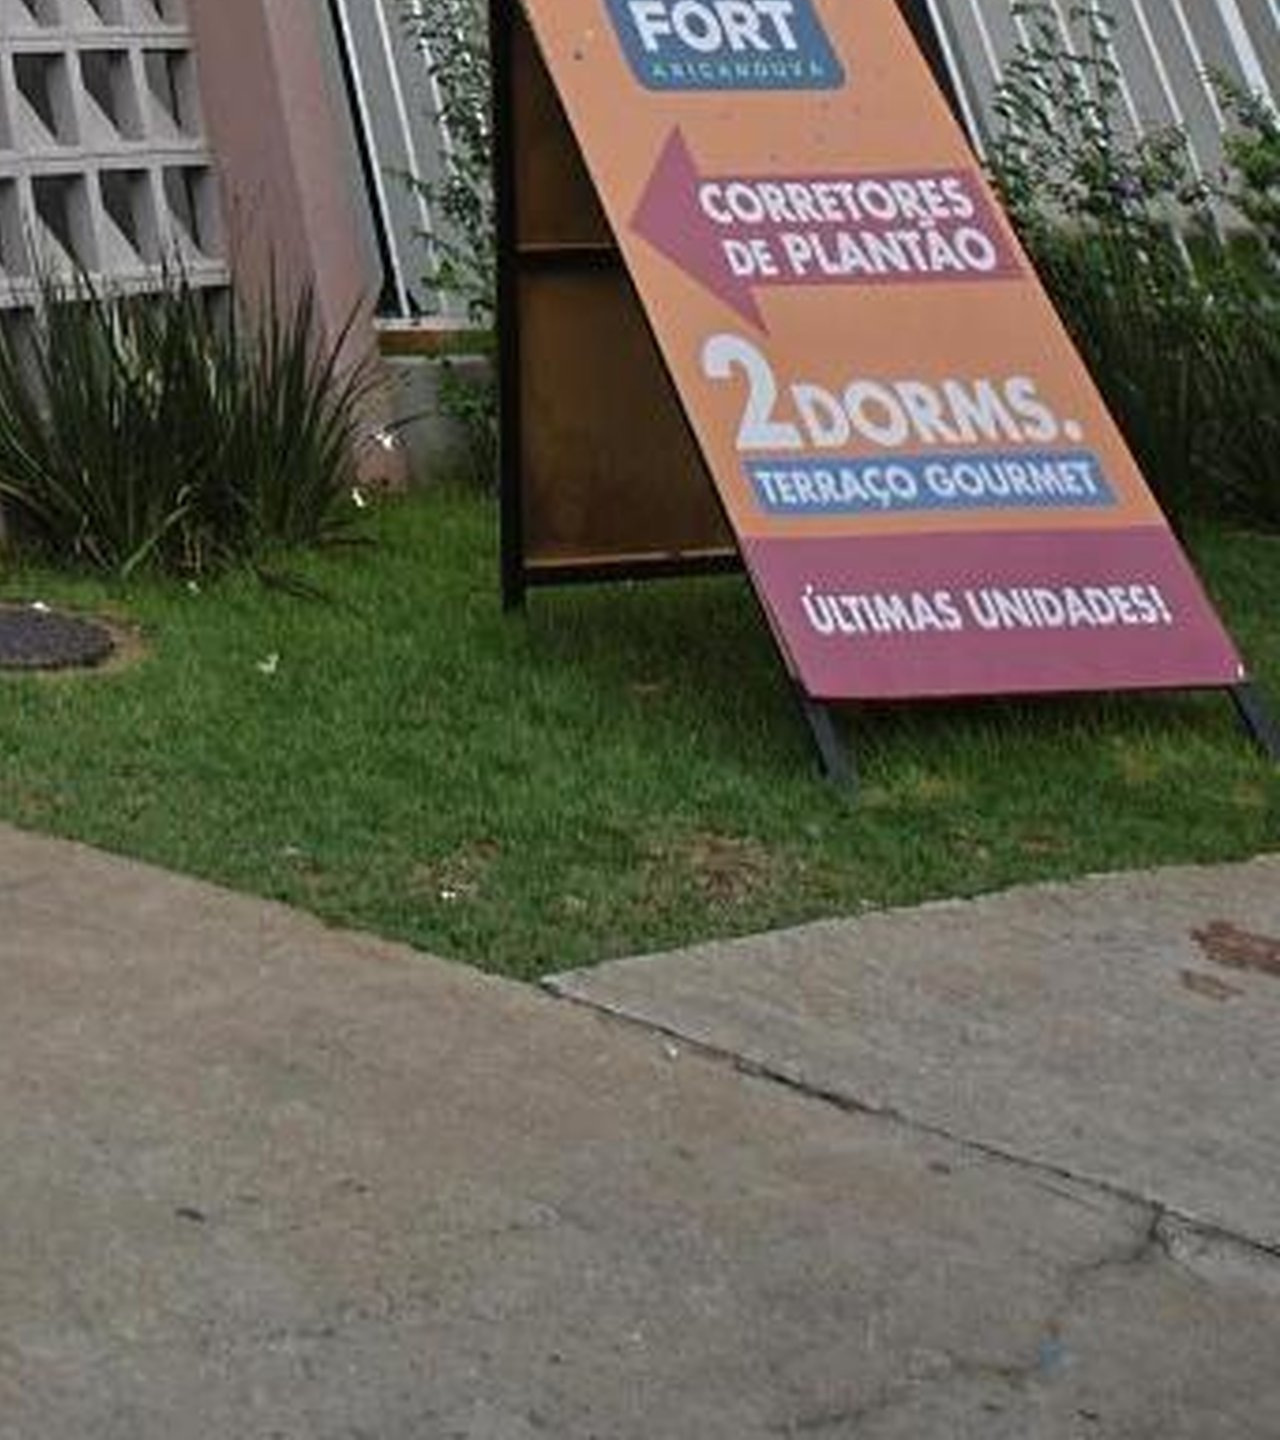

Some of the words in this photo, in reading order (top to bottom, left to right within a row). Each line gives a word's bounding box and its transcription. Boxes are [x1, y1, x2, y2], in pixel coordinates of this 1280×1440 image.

[698, 177, 975, 224] CORRETORES
[722, 238, 779, 276] DE
[781, 217, 998, 276] PLANTÃO
[754, 466, 919, 508] TERRAÇO
[925, 460, 1100, 497] GOURMET
[801, 584, 963, 635] ÚLTIMAS
[965, 585, 1173, 630] UNIDADES!
